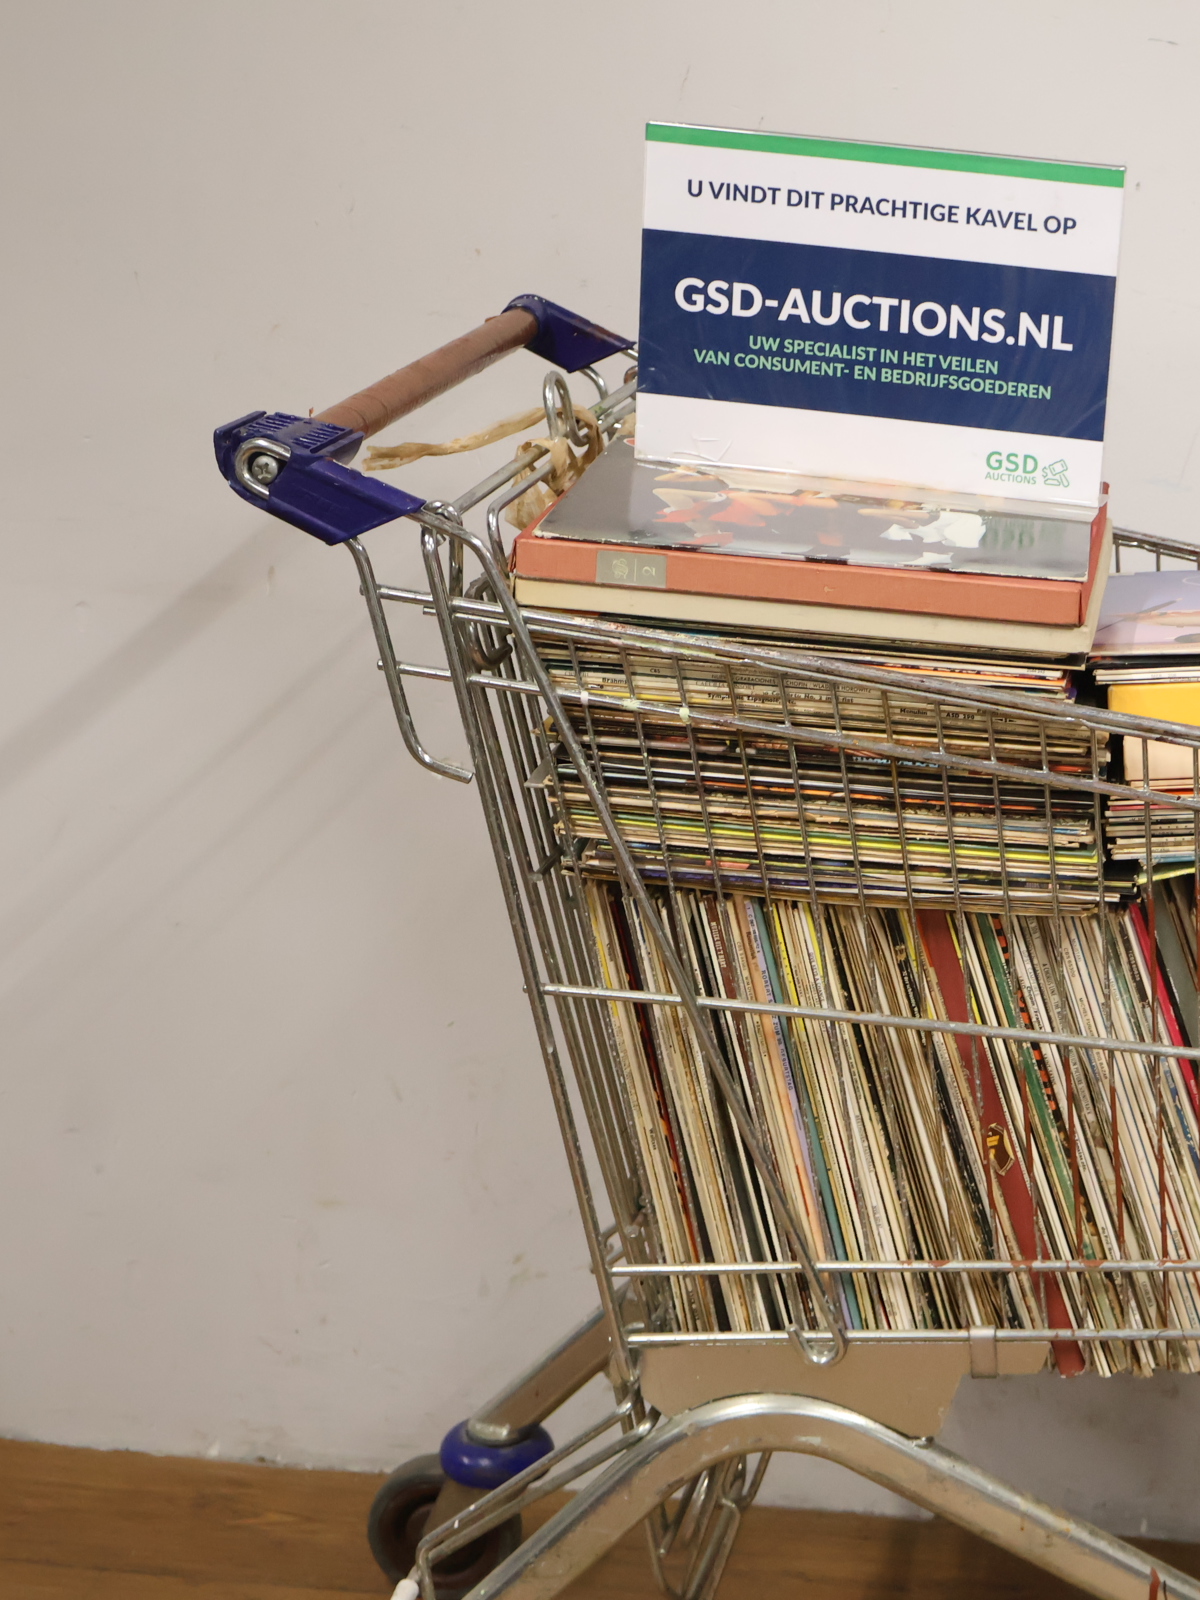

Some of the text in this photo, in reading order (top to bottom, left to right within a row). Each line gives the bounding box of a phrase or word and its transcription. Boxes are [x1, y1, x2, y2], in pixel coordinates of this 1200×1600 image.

[687, 178, 1078, 235] U VINDT DIT PRACHTIGE KAVEL OP
[673, 276, 1074, 352] GSD-AUCTIONS.NL
[748, 334, 999, 376] UW SPECIALIST IN HET VEILEN
[693, 348, 1052, 400] VAN CONSUMENT- EN BEDRIJFSGOEDEREN
[985, 451, 1039, 475] GSD
[984, 471, 1037, 486] AUCTIONS
[735, 675, 776, 685] GRABACIONES
[785, 679, 873, 694] CHOPIN HOROWITZ
[946, 711, 960, 719] ASD
[1127, 952, 1135, 963] CBS
[815, 981, 825, 1002] CHANGE
[1042, 966, 1053, 985] CHORUS
[1048, 985, 1056, 996] LINE
[1112, 987, 1120, 1001] FULD
[1024, 985, 1036, 1007] Chopin
[1033, 1009, 1044, 1030] Franck
[1063, 946, 1071, 959] CBS
[1078, 996, 1089, 1018] MICHEL
[1094, 1050, 1102, 1062] BIG
[1098, 1061, 1108, 1080] BAZAR
[759, 969, 772, 998] ROBERT
[771, 1021, 780, 1037] ZUM
[777, 1048, 793, 1092] GEBURTSTAG
[1073, 1066, 1083, 1086] PICTURE
[1078, 1085, 1092, 1115] SOUNDTRACK
